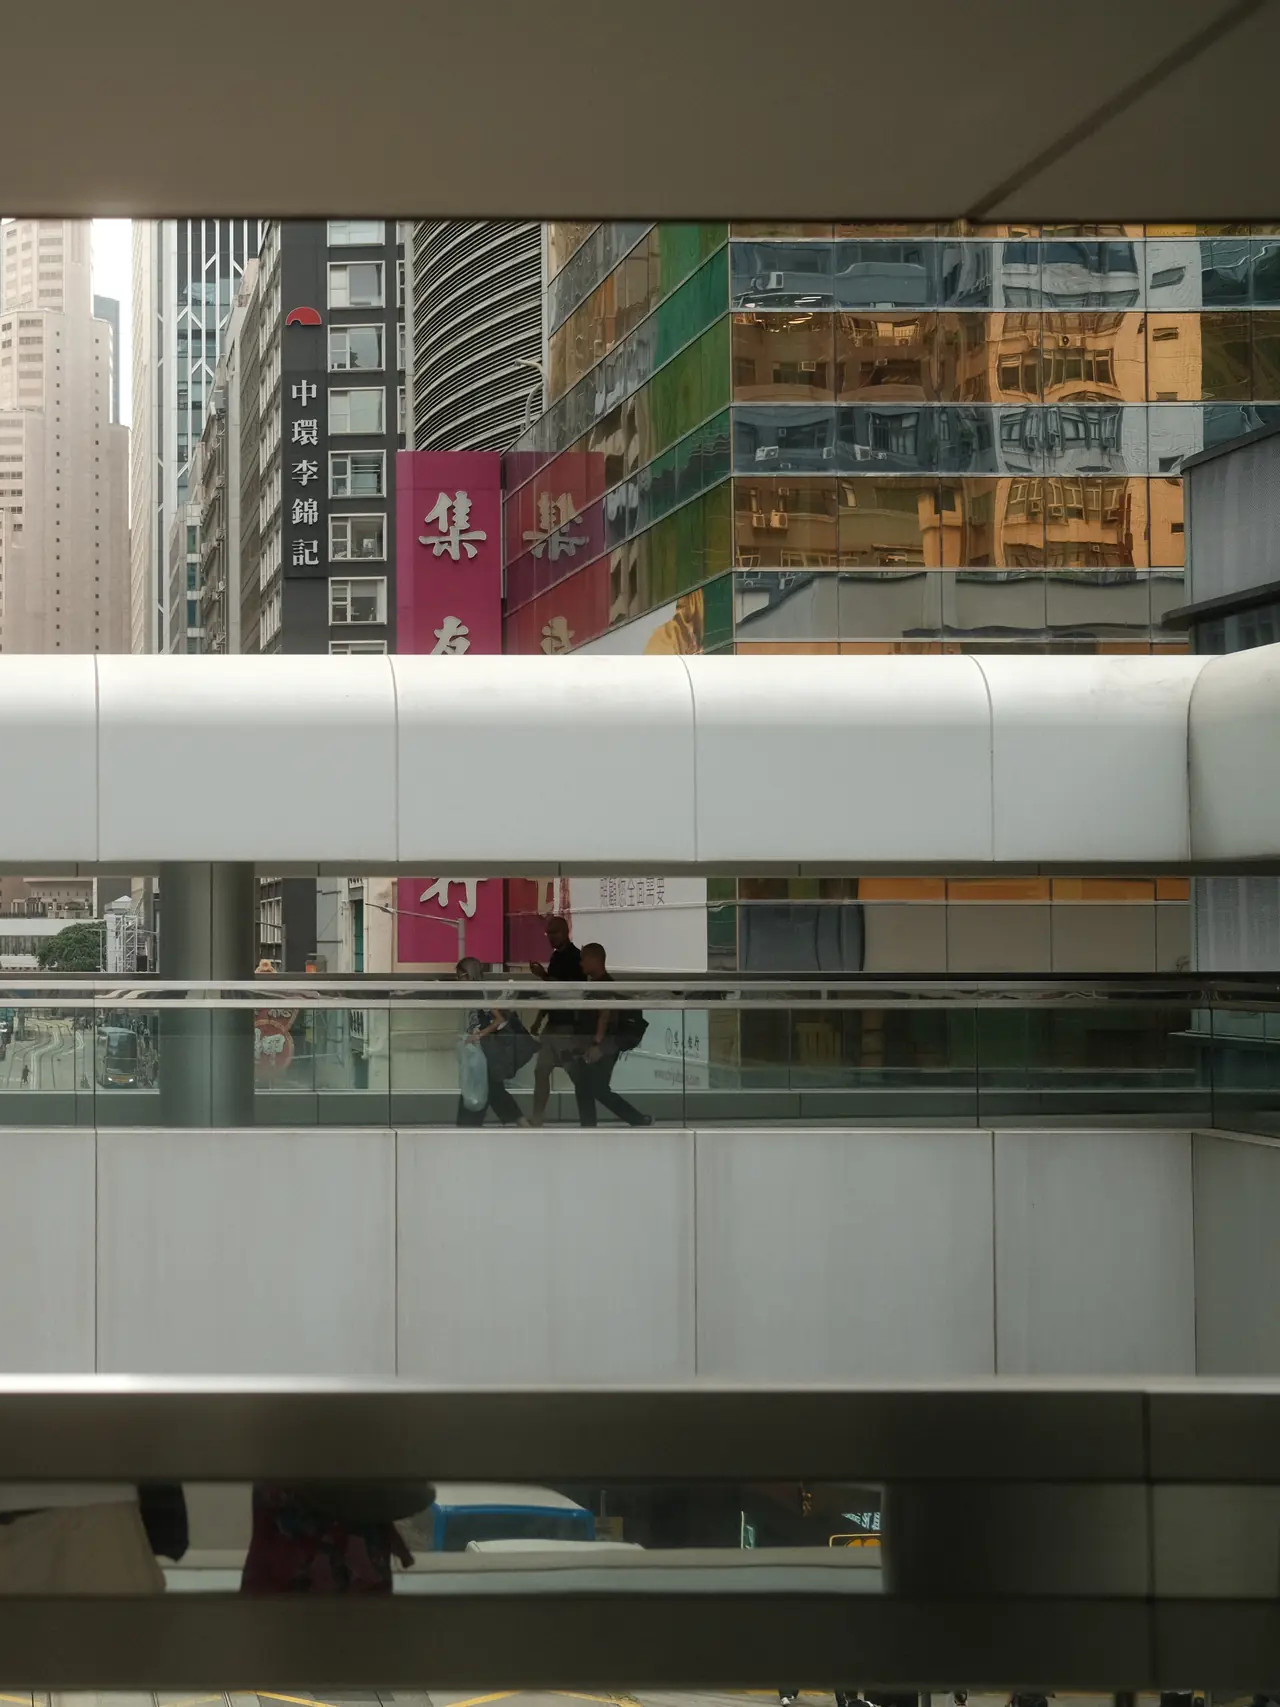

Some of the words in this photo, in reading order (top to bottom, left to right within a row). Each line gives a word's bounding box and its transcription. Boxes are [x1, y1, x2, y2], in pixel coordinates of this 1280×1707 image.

[291, 378, 319, 566] 中環李錦記
